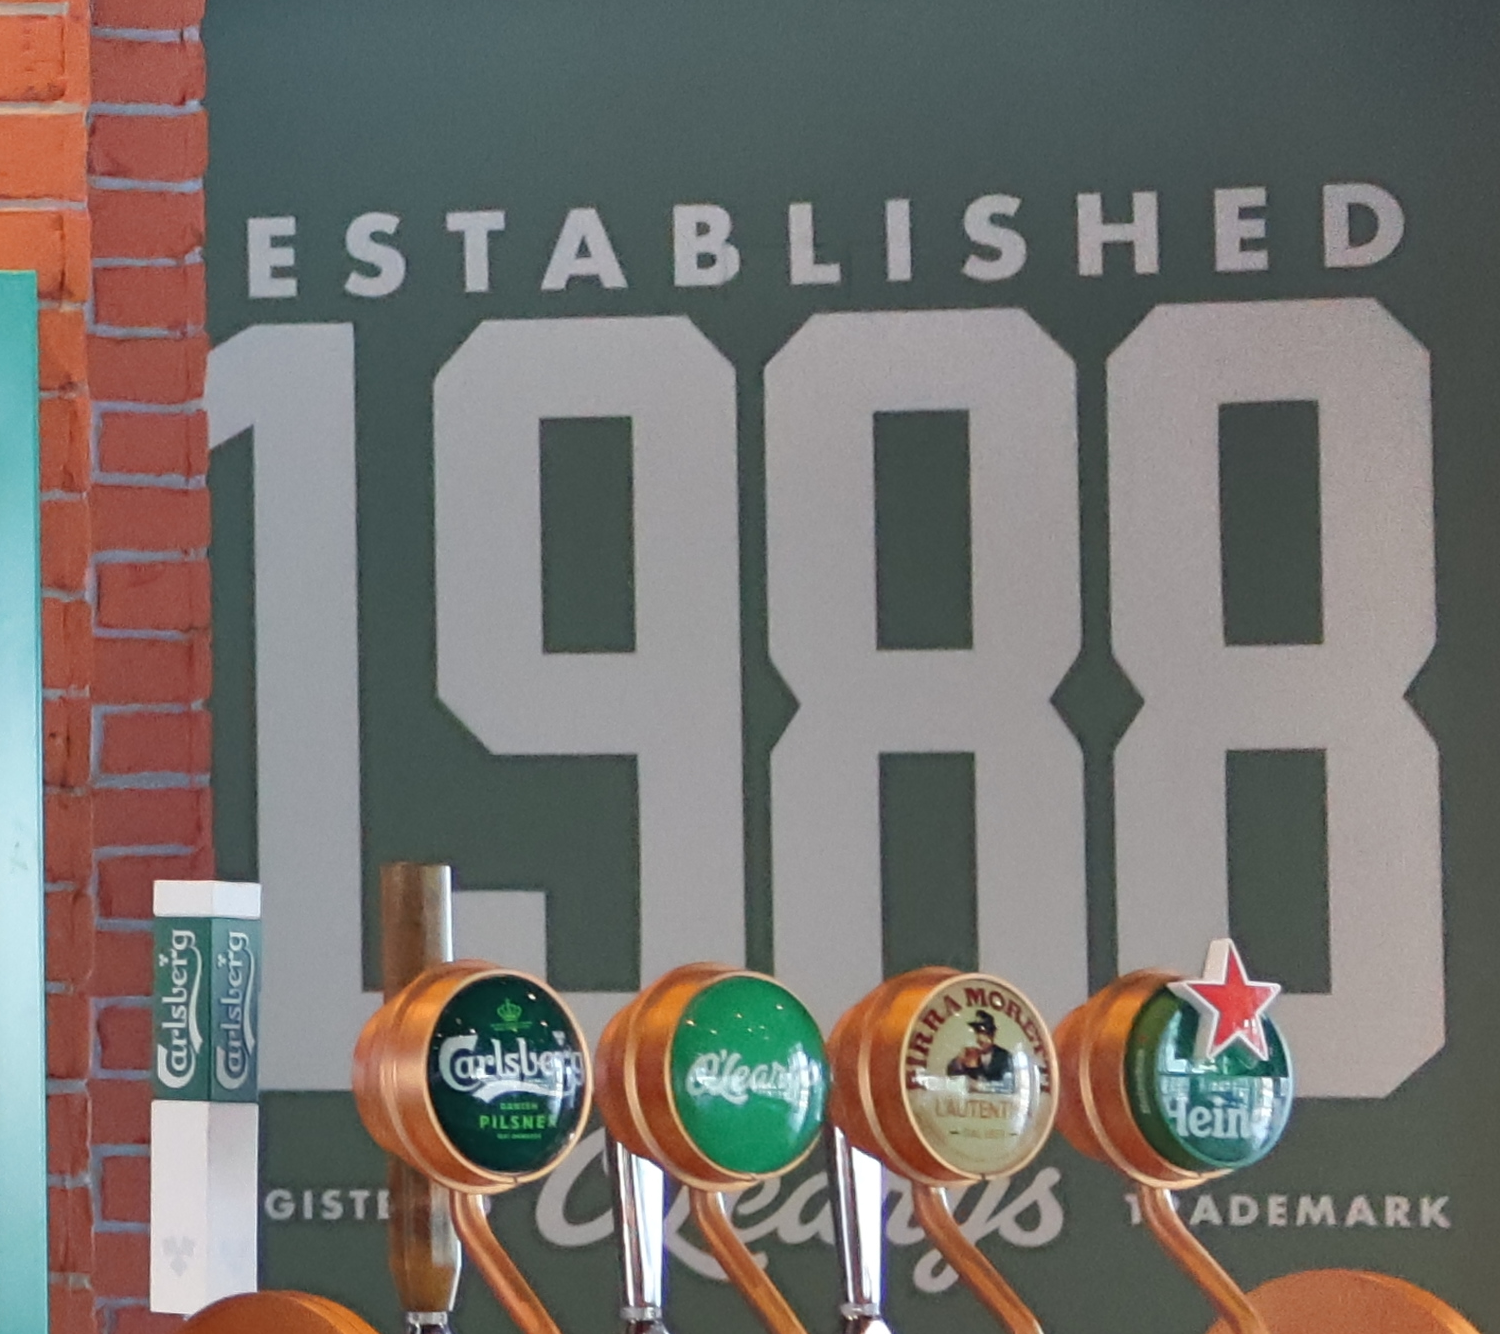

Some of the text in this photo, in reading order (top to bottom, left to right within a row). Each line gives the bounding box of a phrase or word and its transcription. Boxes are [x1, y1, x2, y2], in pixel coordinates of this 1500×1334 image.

[244, 183, 1408, 300] ESTABLISHED
[205, 297, 1446, 1099] 1988
[156, 928, 204, 1090] Carlsberg
[215, 930, 257, 1091] Carlsberg
[438, 1033, 585, 1093] Carlsberg
[478, 1114, 558, 1130] PILSNER
[1122, 1192, 1452, 1229] TADEMARK
